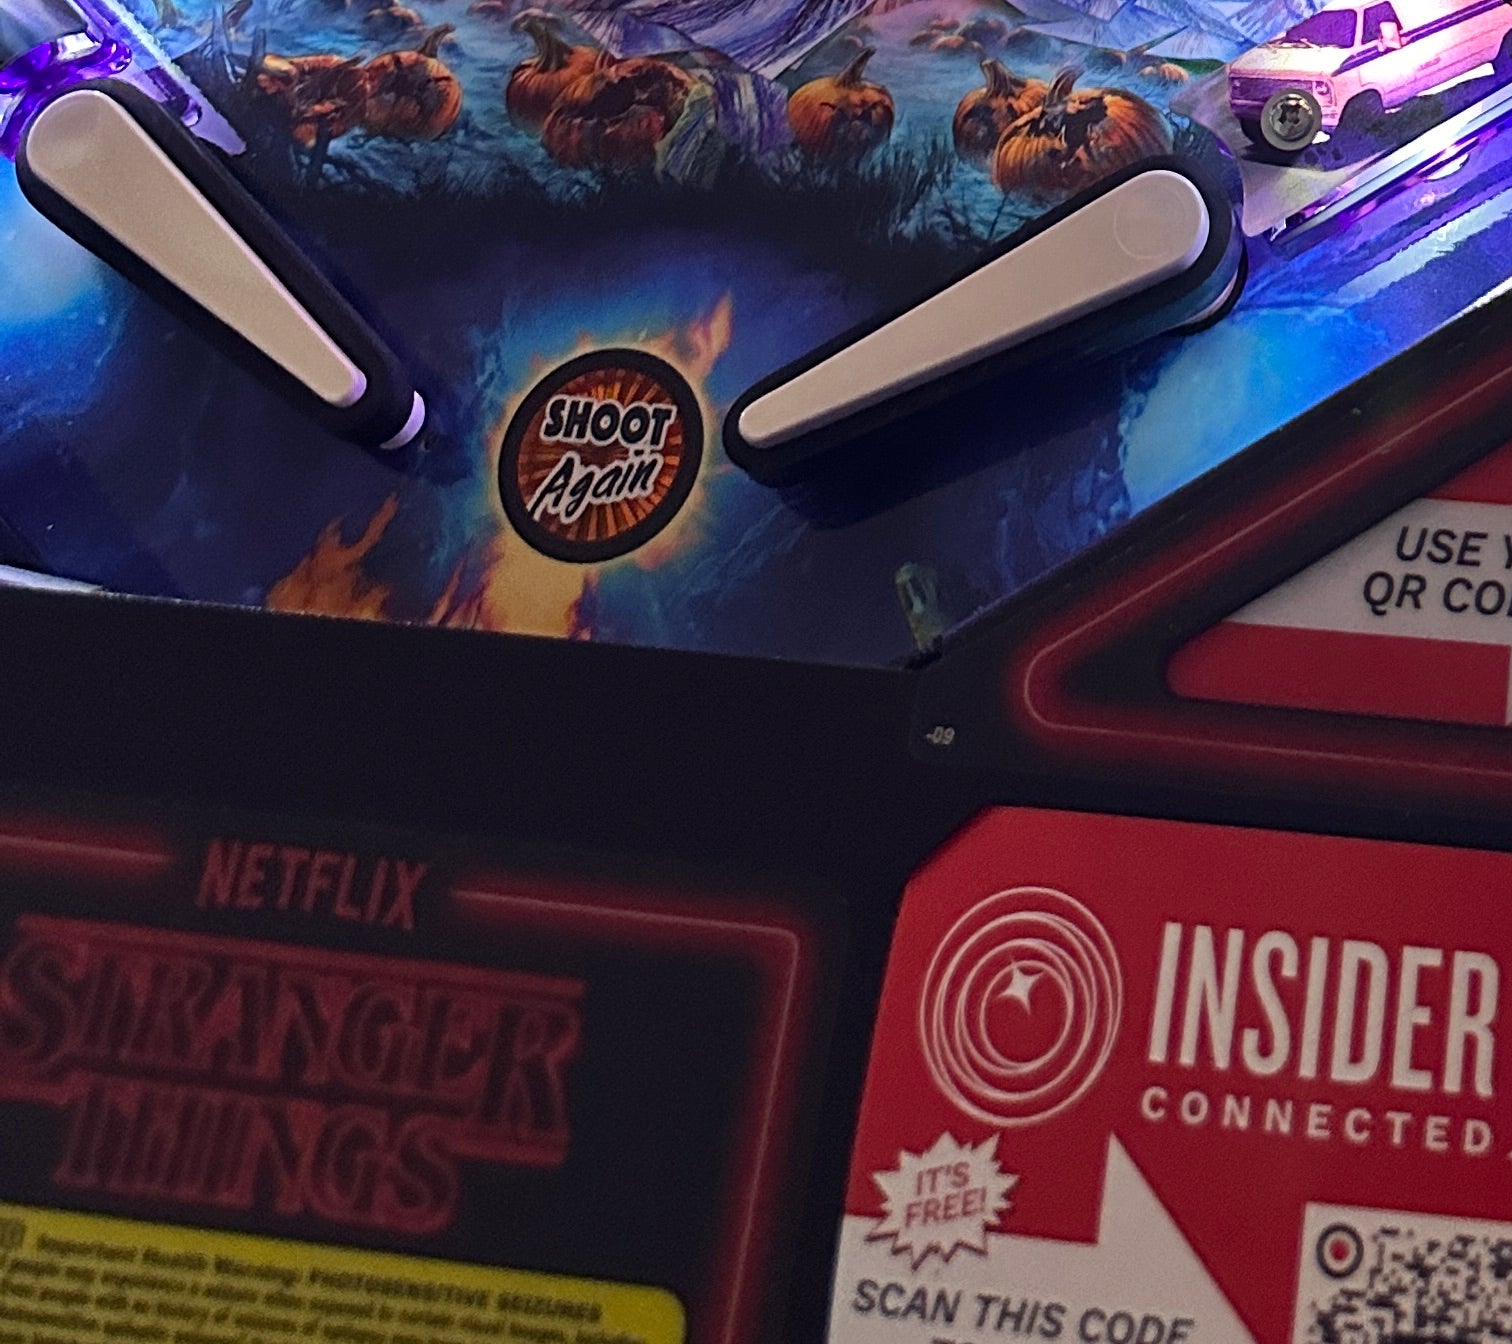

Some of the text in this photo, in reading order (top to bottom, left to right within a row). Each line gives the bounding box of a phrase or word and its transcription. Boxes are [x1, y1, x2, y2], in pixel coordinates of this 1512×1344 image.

[543, 397, 674, 447] SHOOT
[529, 448, 660, 520] Again
[1396, 525, 1488, 568] USE
[1362, 570, 1428, 617] QR
[197, 838, 428, 931] NETFLIX
[0, 937, 583, 1144] STRANGER
[1147, 921, 1501, 1099] INSIDER
[1139, 1085, 1496, 1156] CONNECTED
[54, 1077, 461, 1234] THINGS
[914, 1160, 972, 1198] IT'S
[904, 1190, 990, 1231] FREE!
[852, 1278, 1195, 1344] SCAN THIS CODE
